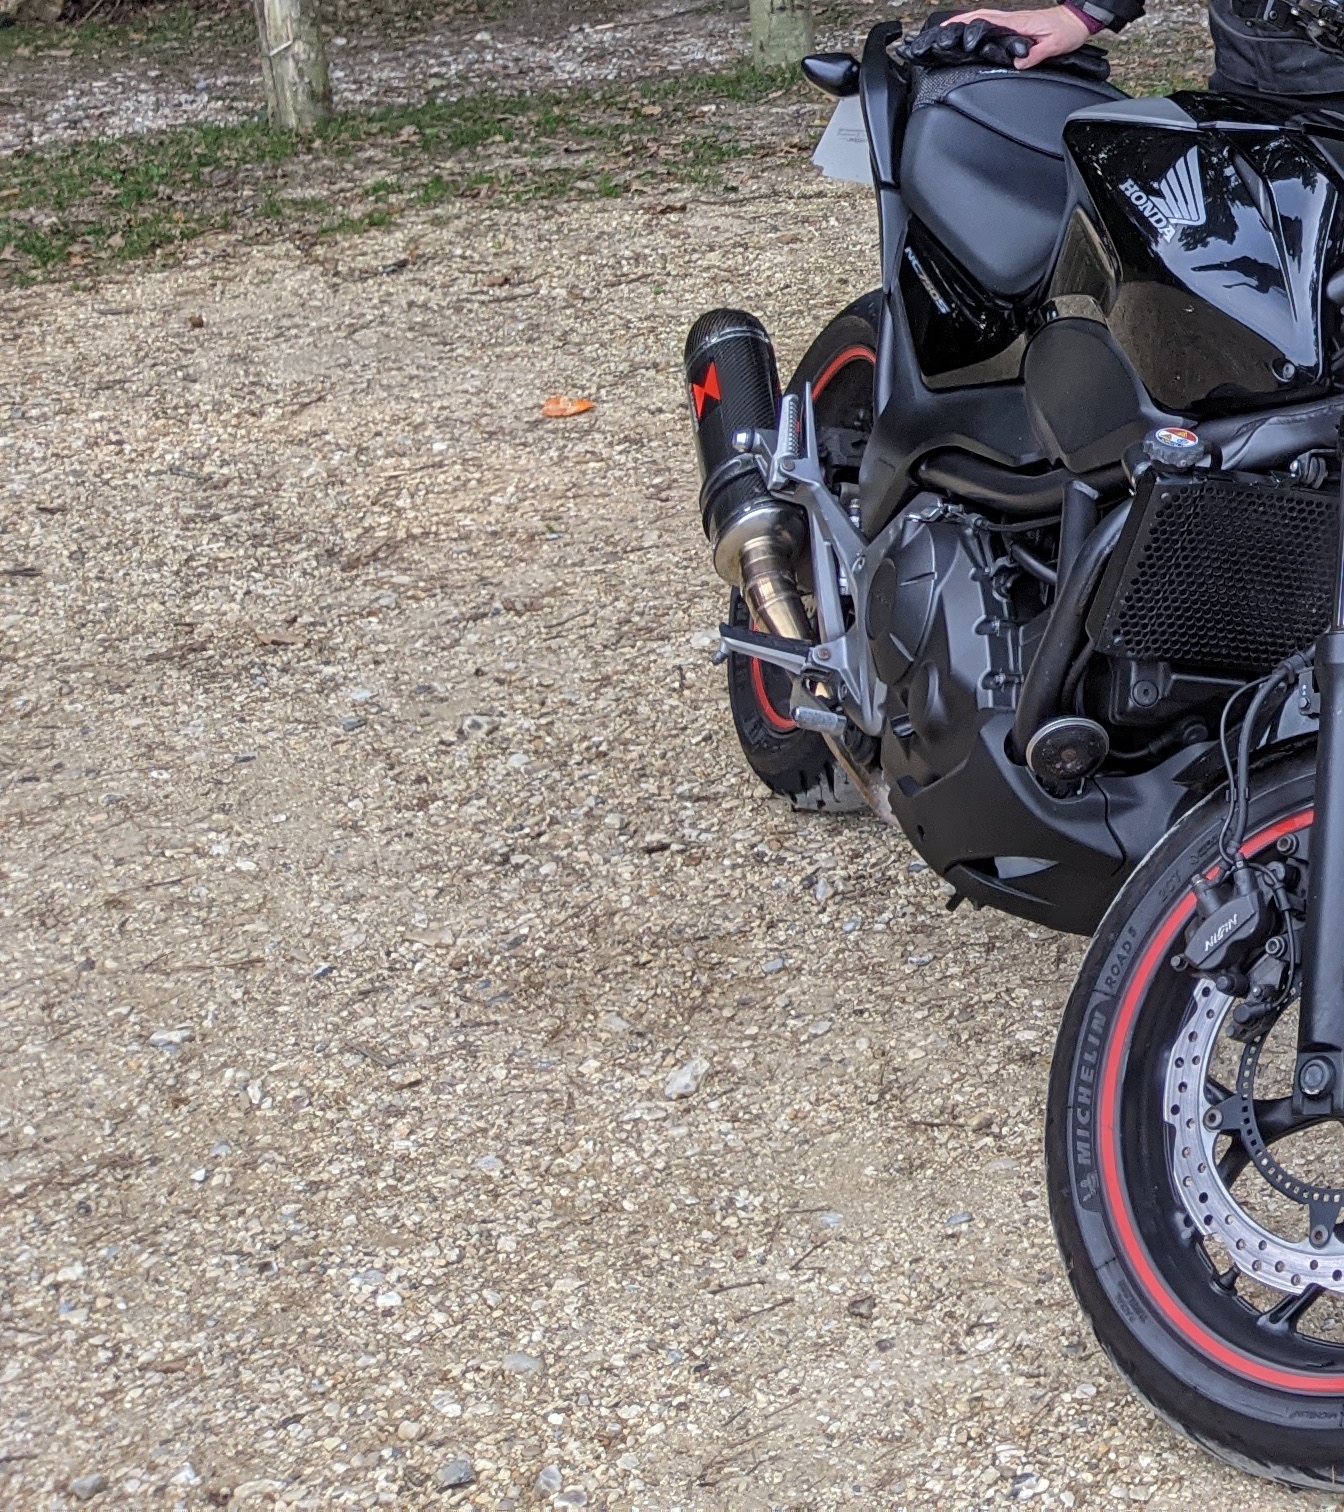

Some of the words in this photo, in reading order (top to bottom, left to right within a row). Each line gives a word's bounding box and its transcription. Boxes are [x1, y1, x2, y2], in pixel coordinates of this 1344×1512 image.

[1118, 178, 1176, 243] HONDA
[1104, 941, 1133, 989] ROAD
[1077, 1008, 1108, 1165] MICHELIN
